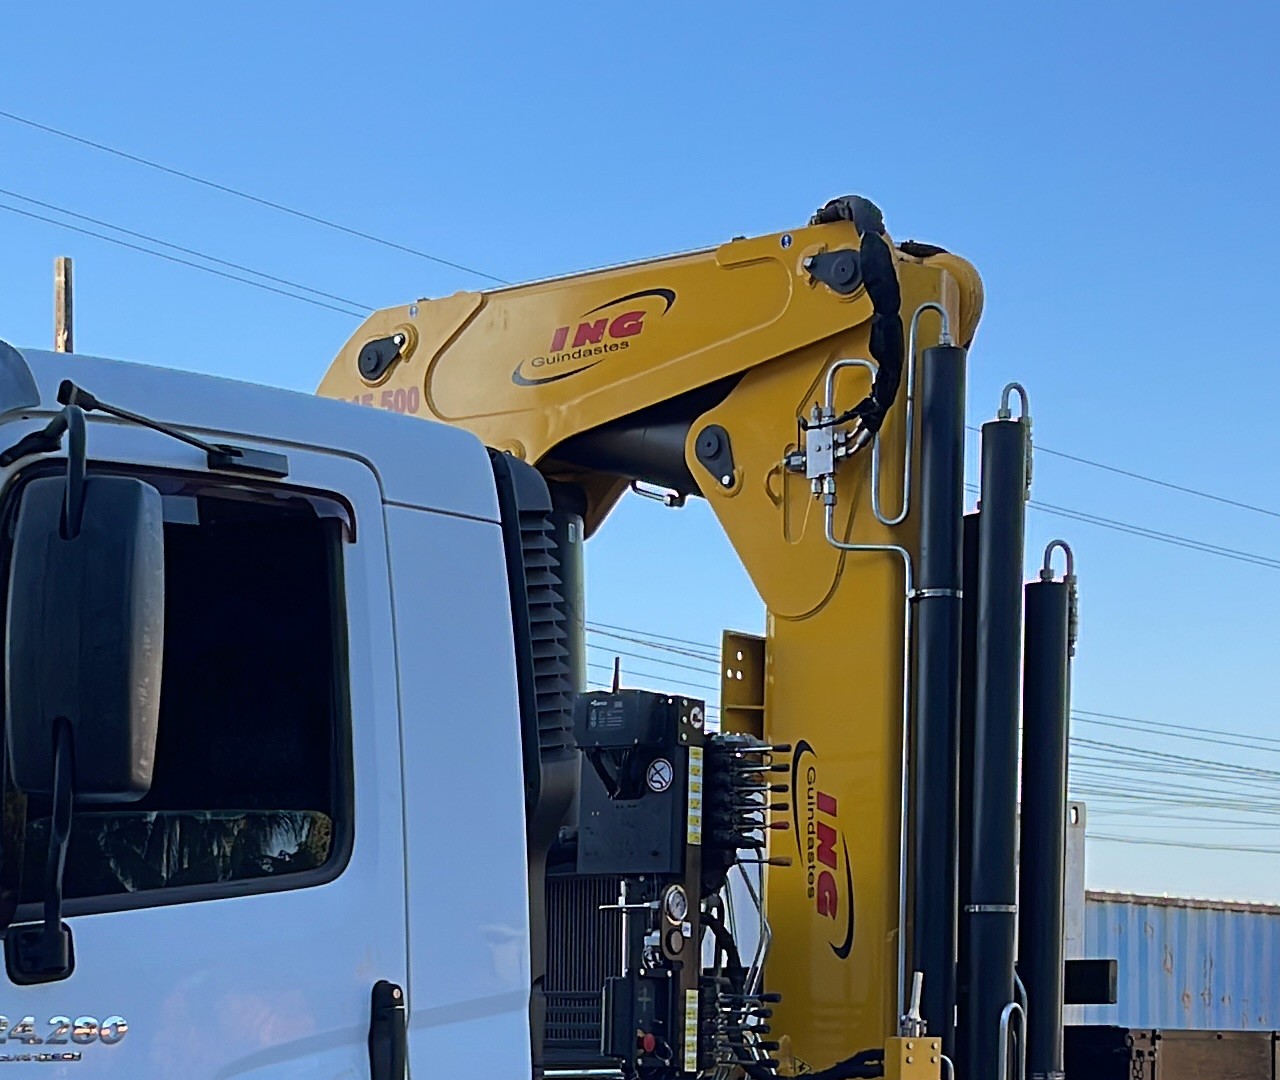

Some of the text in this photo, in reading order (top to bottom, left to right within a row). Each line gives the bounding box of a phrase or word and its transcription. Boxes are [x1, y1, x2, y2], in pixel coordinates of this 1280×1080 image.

[531, 340, 630, 368] Guindastes
[550, 311, 647, 353] ING
[806, 766, 816, 899] Guindastes
[816, 791, 838, 920] ING
